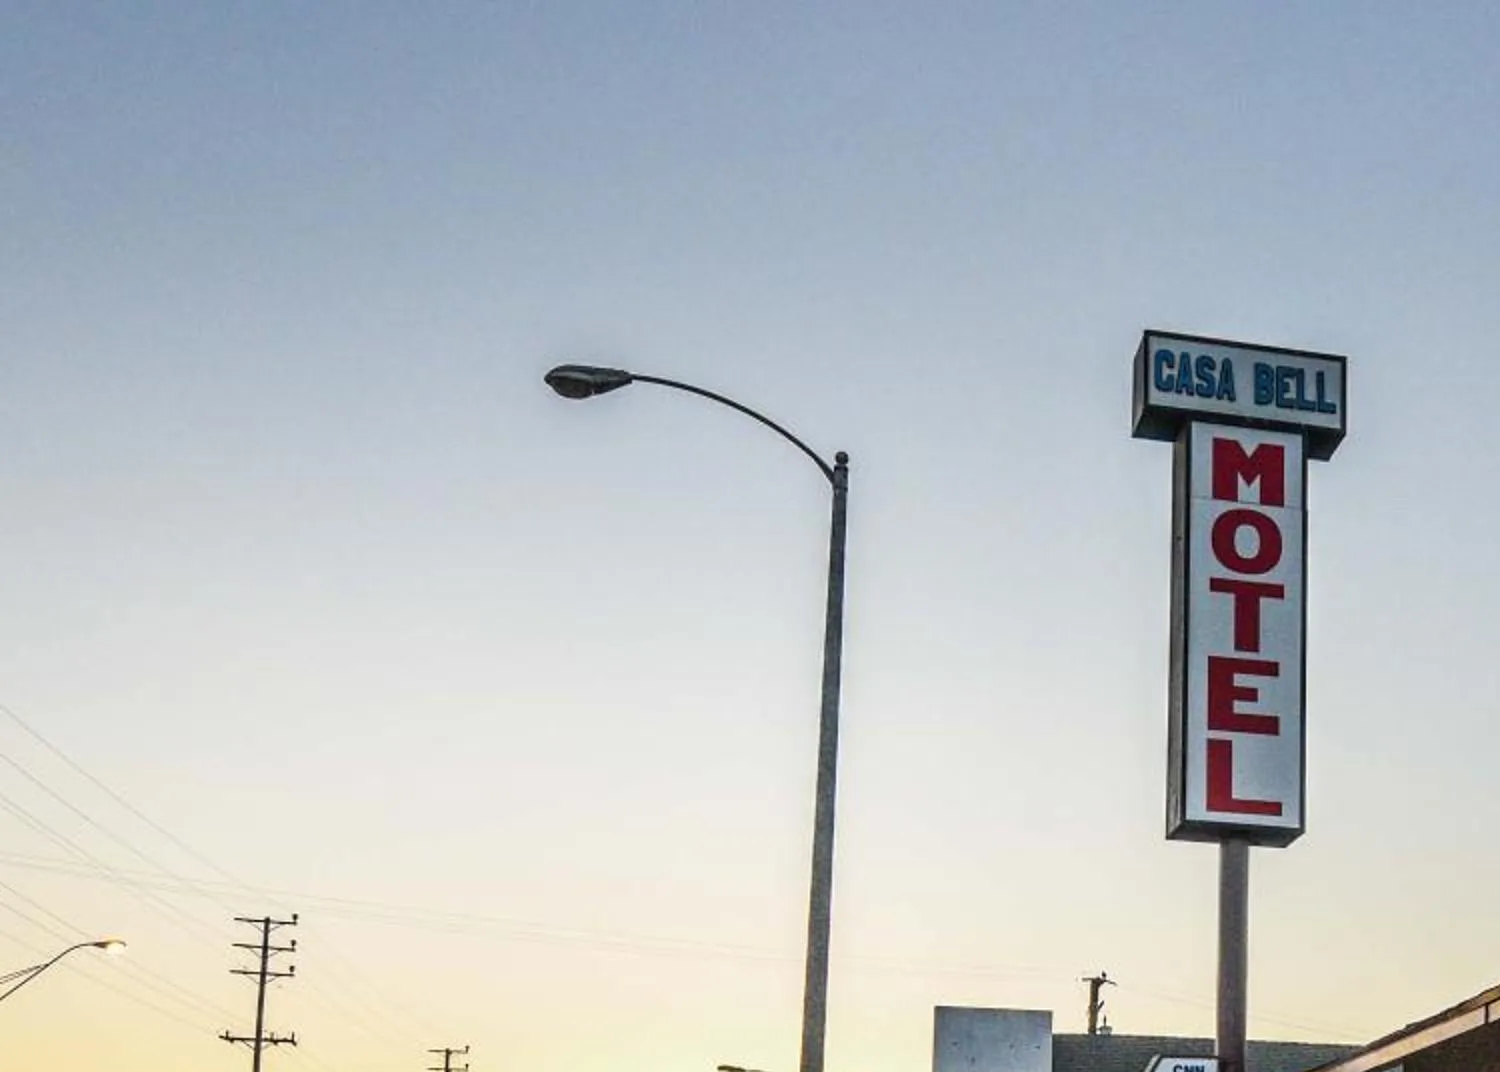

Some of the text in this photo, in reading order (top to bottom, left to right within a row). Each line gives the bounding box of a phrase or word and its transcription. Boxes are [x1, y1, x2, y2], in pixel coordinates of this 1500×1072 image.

[1153, 348, 1336, 414] CASA BELL
[1206, 437, 1285, 816] MOTEL
